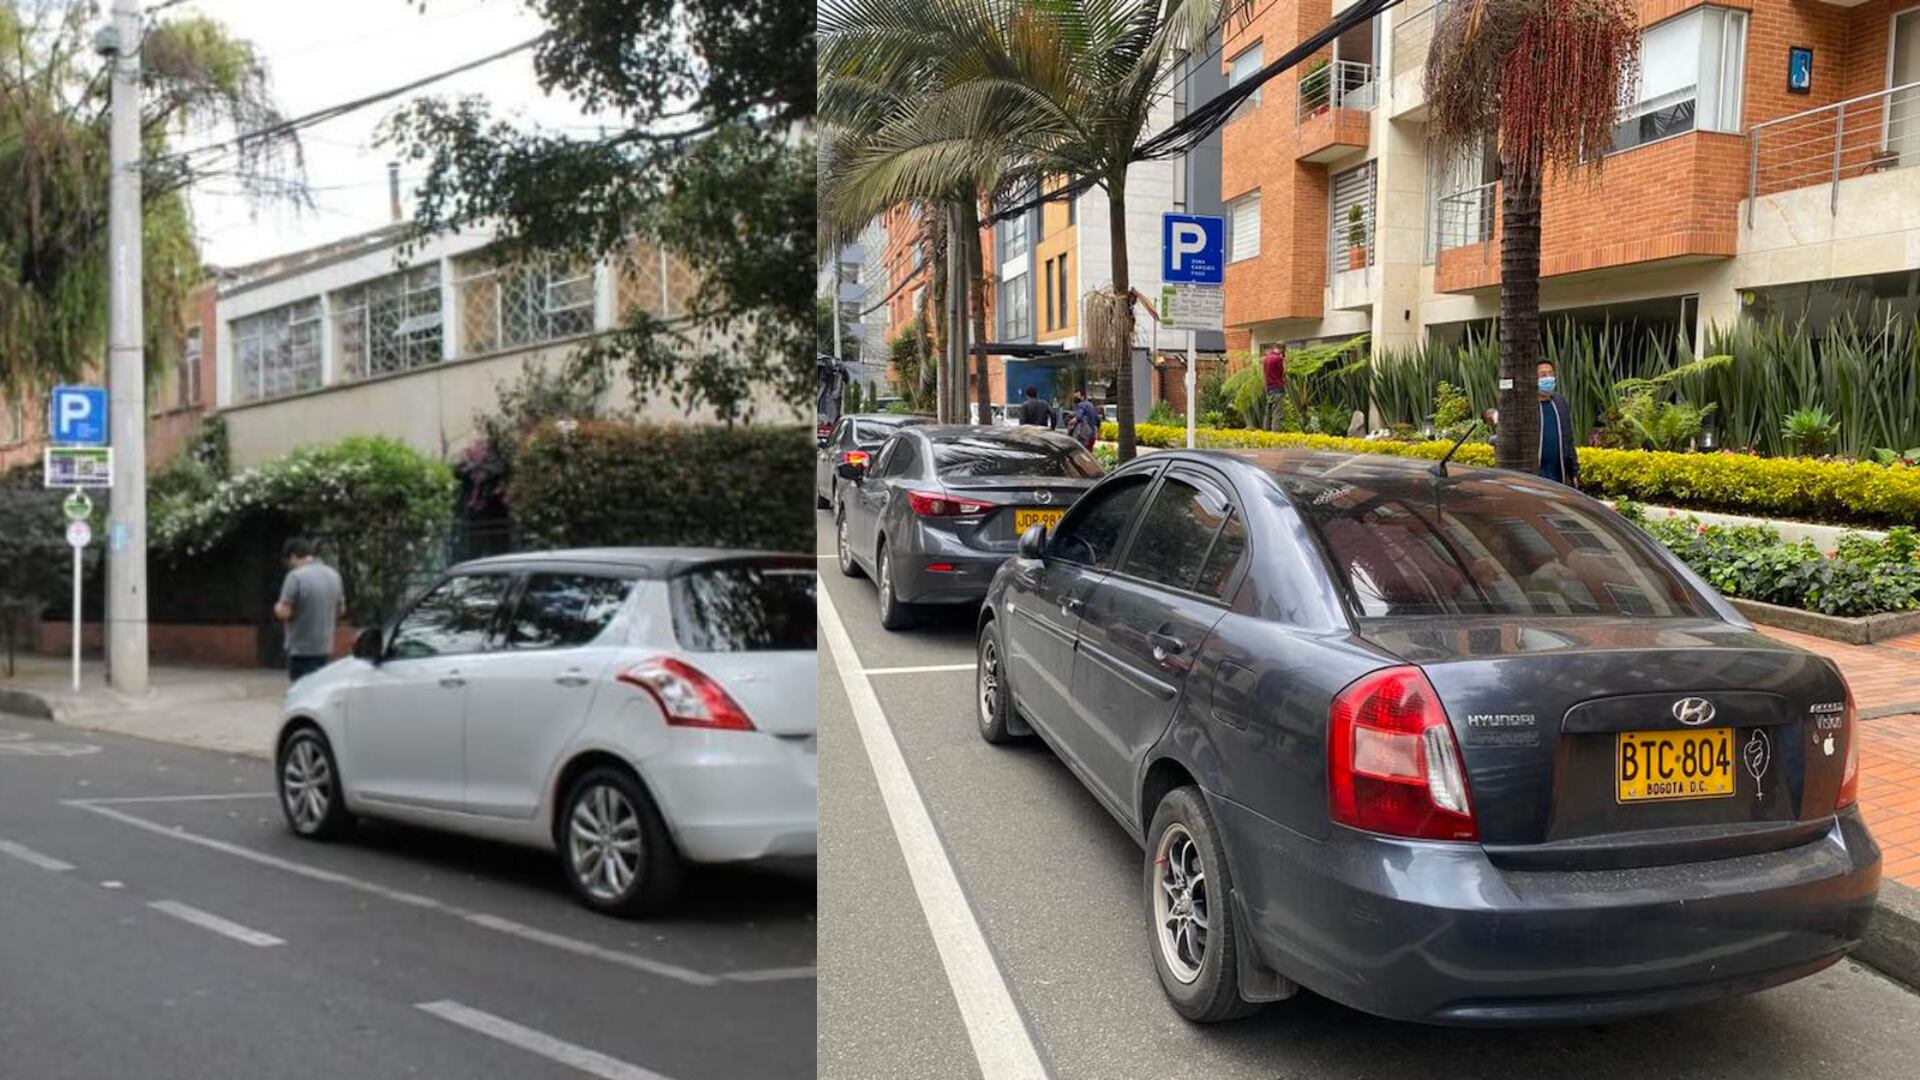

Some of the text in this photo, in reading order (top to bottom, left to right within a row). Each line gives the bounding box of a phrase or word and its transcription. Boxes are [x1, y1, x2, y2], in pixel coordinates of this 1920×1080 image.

[1172, 222, 1207, 270] P
[60, 393, 91, 433] P
[1468, 714, 1536, 727] HYUNDAI
